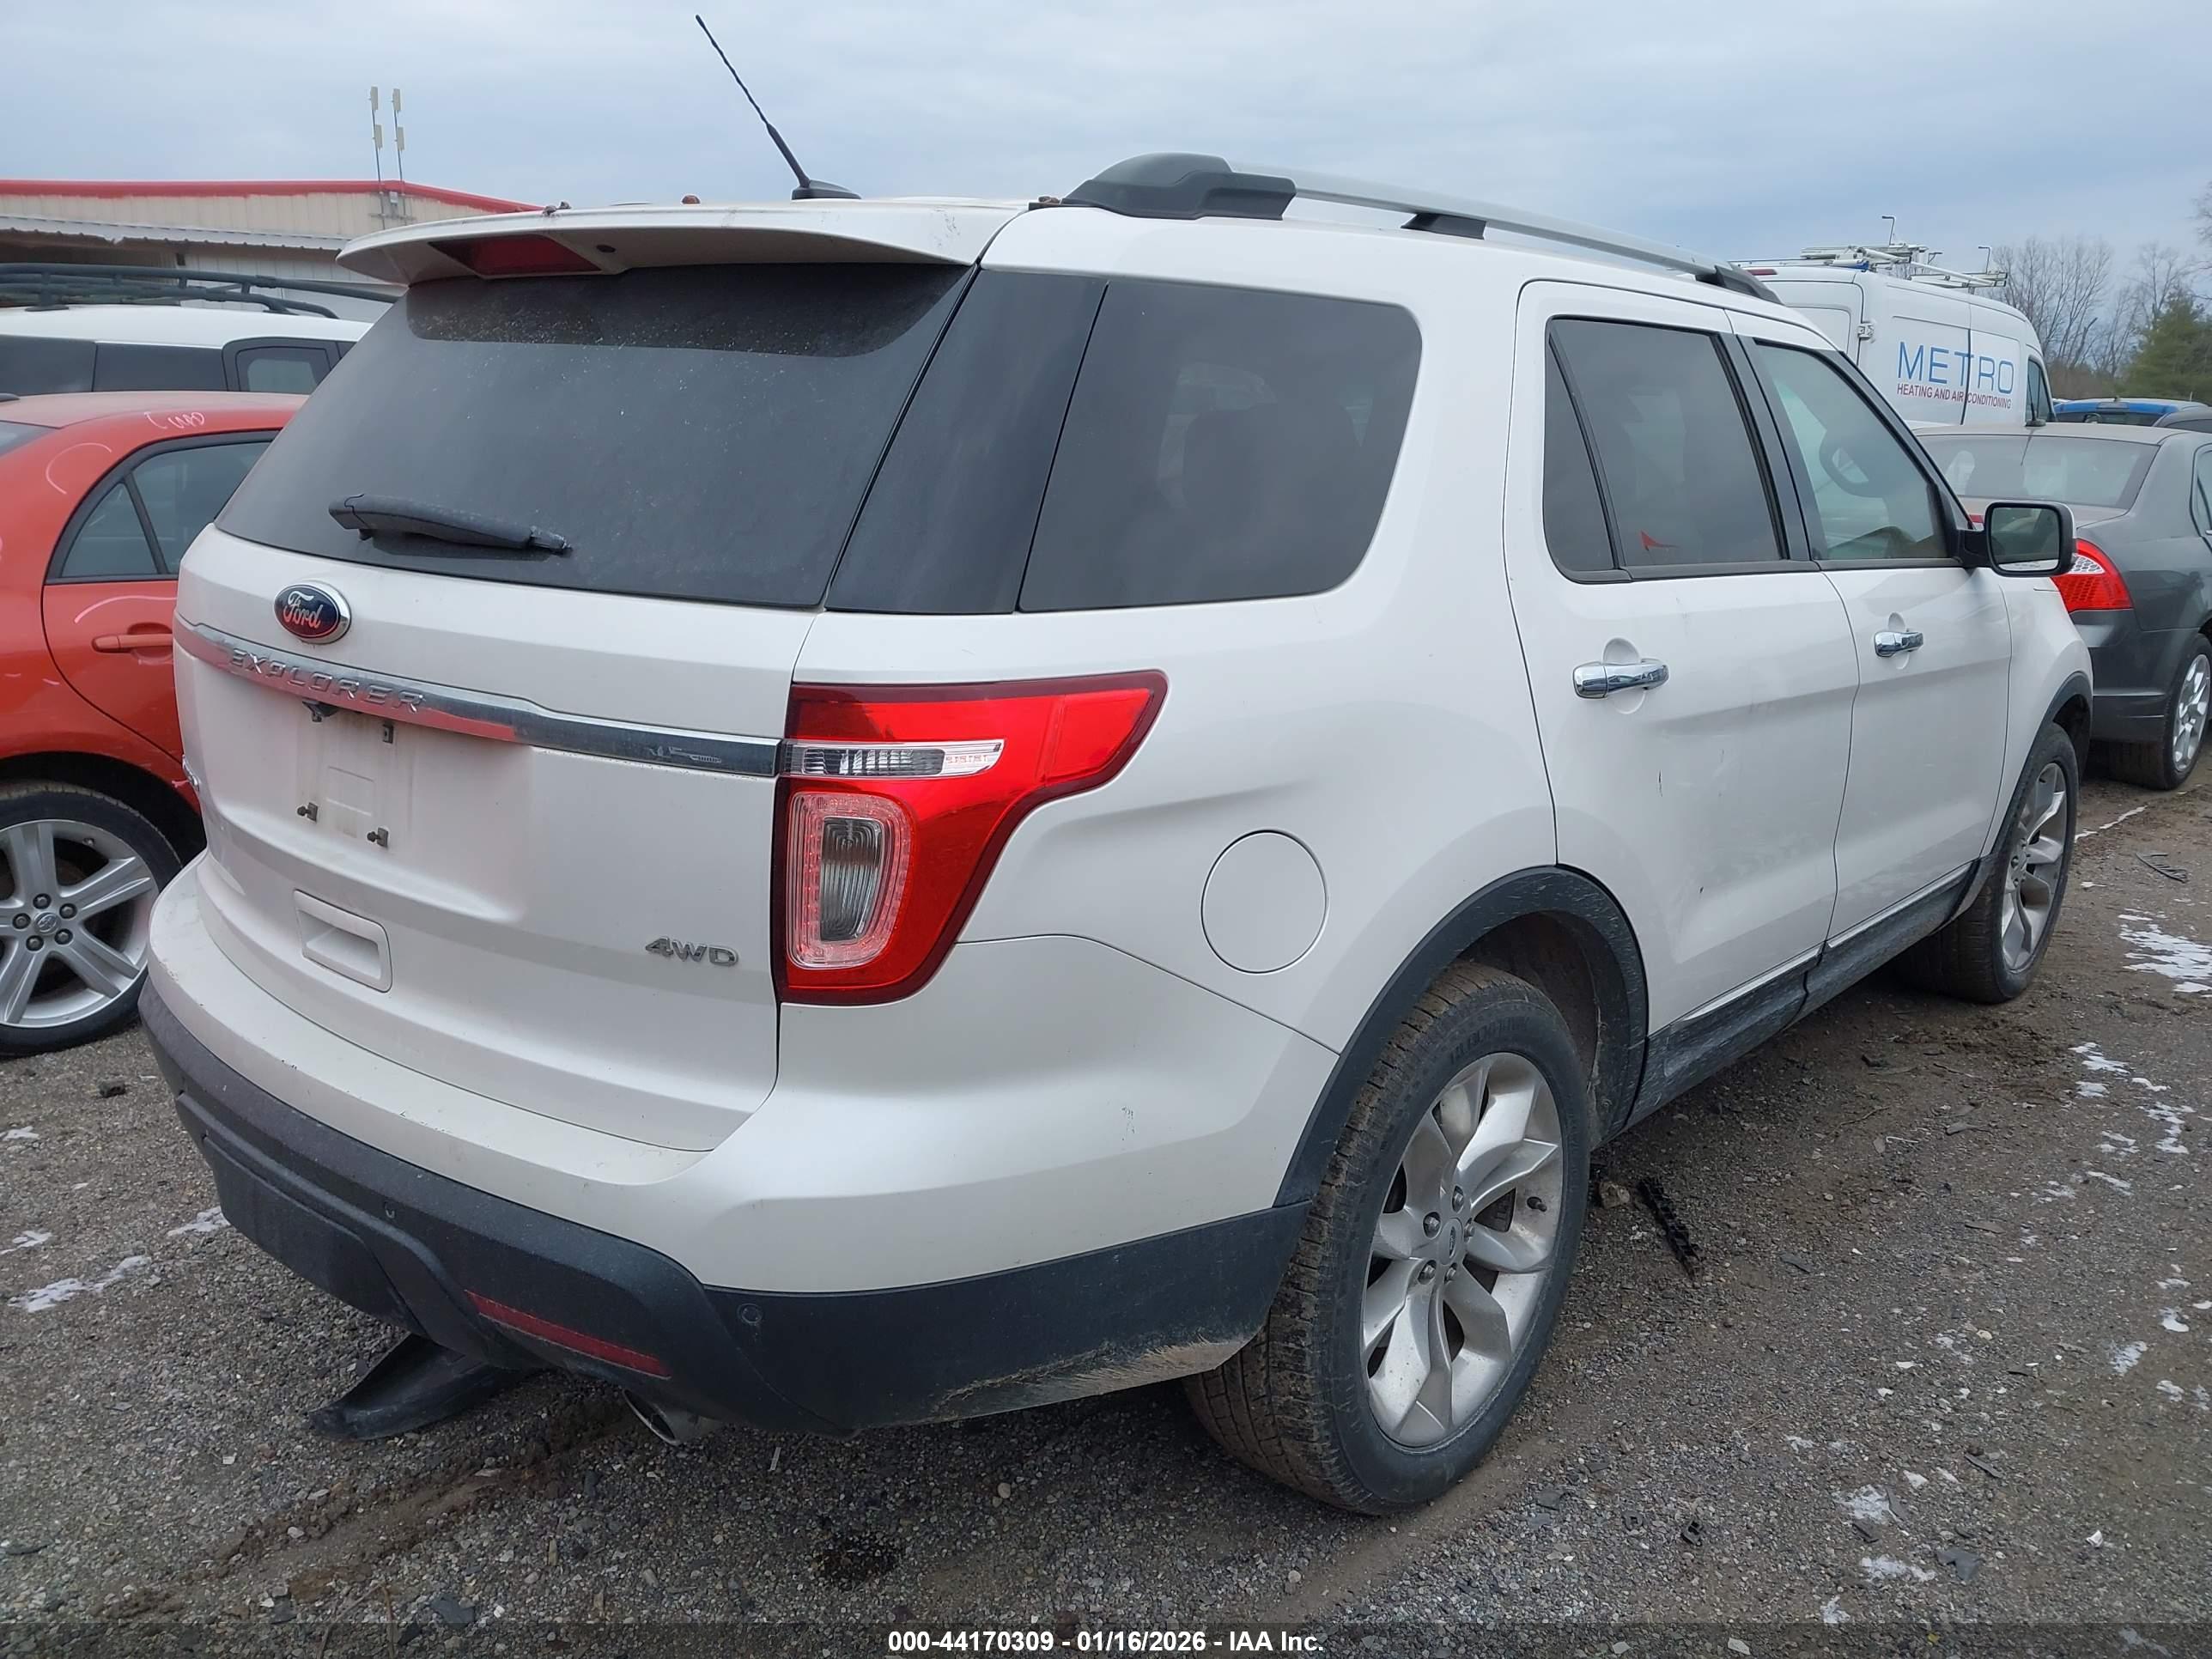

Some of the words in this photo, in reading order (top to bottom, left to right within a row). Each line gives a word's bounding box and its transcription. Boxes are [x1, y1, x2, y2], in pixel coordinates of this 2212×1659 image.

[1897, 341, 2014, 395] METRO
[1897, 383, 1933, 398] HEATING
[1934, 390, 1951, 401] AND
[1952, 391, 1964, 402] AIR
[1966, 393, 2012, 410] CONDITIONING
[283, 590, 324, 629] Ford
[229, 647, 425, 714] EXPLORER
[645, 936, 738, 967] 4WD
